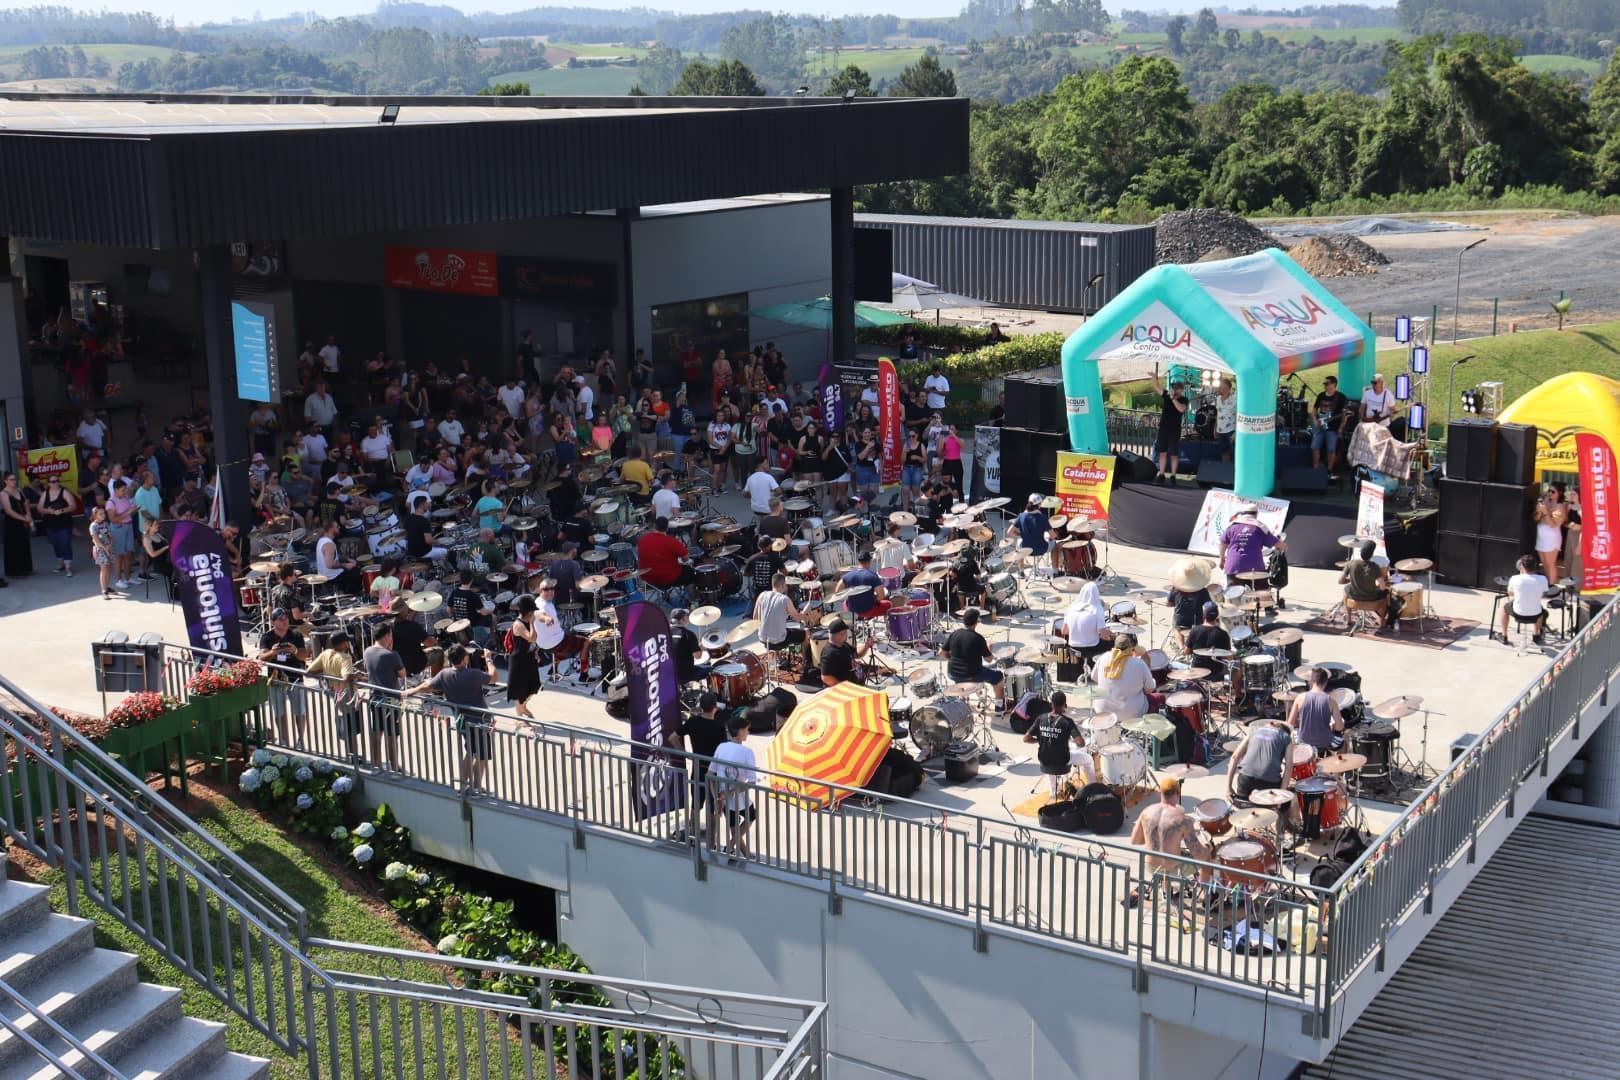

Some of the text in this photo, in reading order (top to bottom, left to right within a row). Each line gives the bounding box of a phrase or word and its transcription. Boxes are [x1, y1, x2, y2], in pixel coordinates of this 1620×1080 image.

[1240, 294, 1328, 330] ACQUA
[1120, 324, 1191, 349] ACQUA
[1133, 343, 1160, 352] Centro
[824, 385, 836, 431] tonia
[1064, 467, 1106, 480] Catarinão
[1591, 447, 1610, 561] Pijurauto
[210, 552, 224, 578] 94.7
[189, 553, 228, 651] sintonia
[657, 633, 670, 663] 94.7
[641, 637, 664, 751] sintonia
